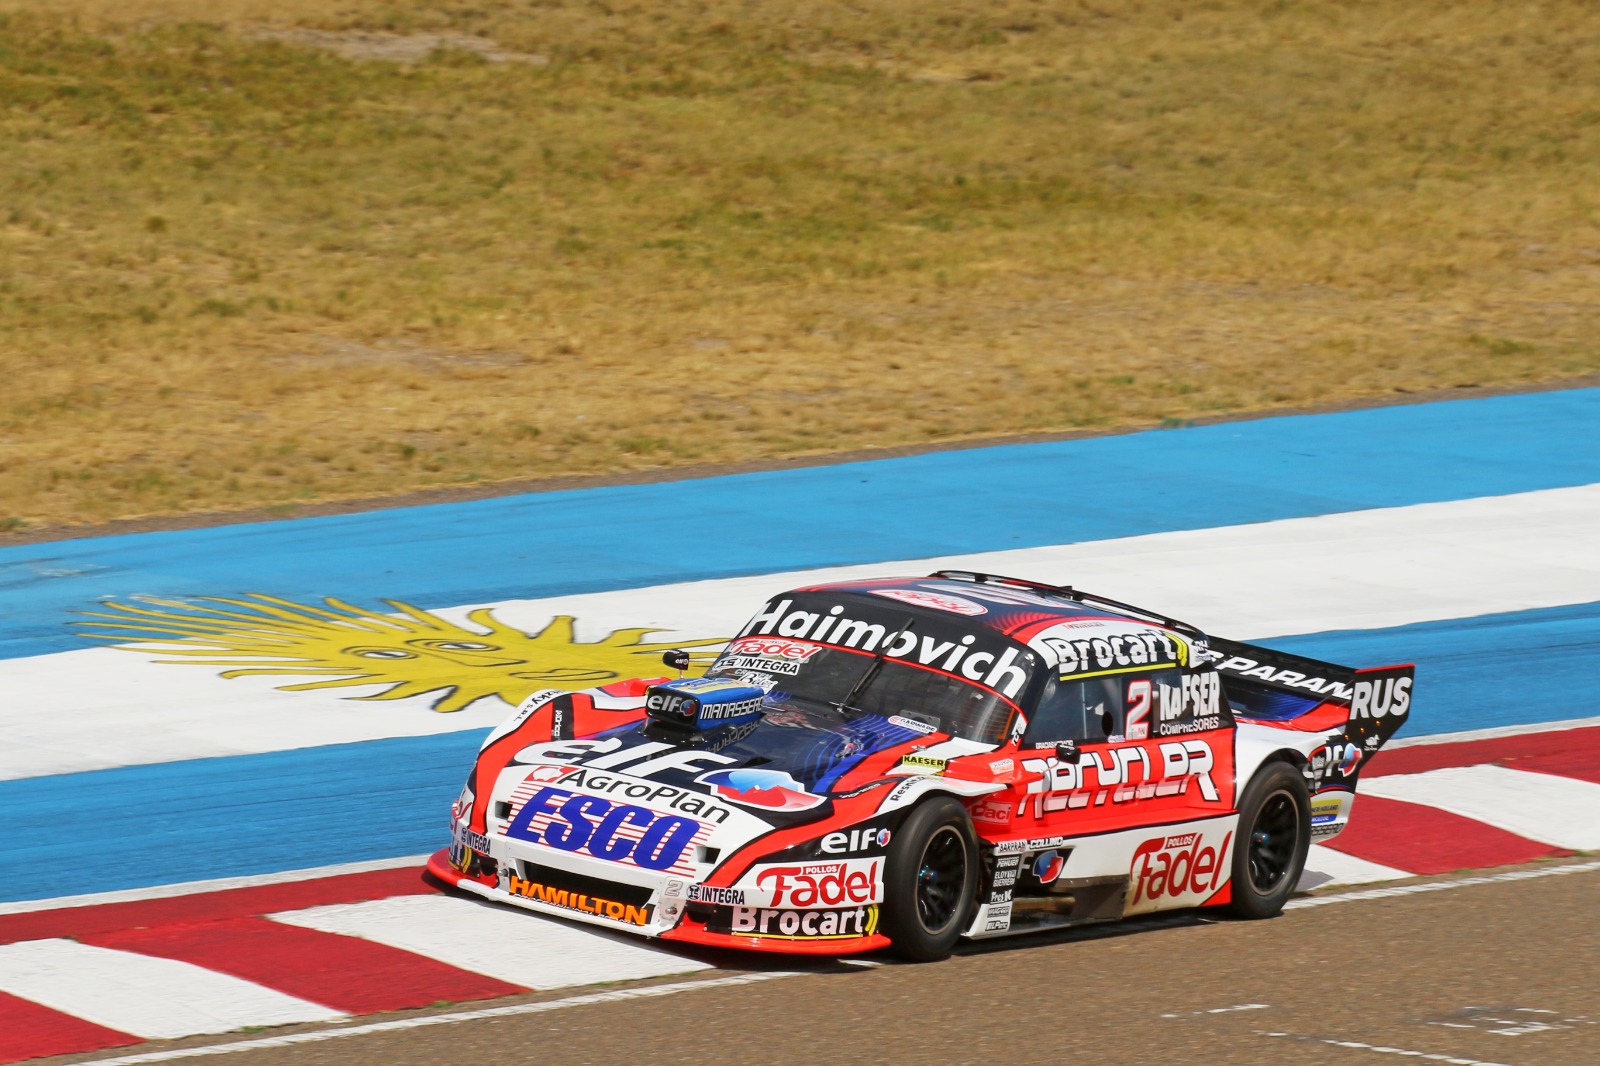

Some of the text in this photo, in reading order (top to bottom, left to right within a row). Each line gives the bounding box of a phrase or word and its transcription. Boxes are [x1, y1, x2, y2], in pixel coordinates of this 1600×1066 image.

[731, 639, 821, 659] Fadel
[741, 599, 1027, 698] Haimovich
[1042, 630, 1178, 674] Brocart
[742, 658, 798, 674] INTEGRA
[647, 694, 682, 713] elf
[1126, 680, 1152, 740] 2
[1160, 671, 1220, 721] KAESER
[1350, 677, 1413, 720] RUS
[1159, 717, 1220, 735] COMPRESORES
[513, 738, 738, 779] elf
[904, 755, 944, 767] KAESER
[467, 830, 491, 855] INTEGRA
[506, 786, 701, 871] ESCO
[821, 828, 877, 853] elf
[1168, 836, 1193, 847] POLLOS
[805, 865, 838, 874] POLLOS
[1130, 830, 1232, 906] Fadel
[701, 887, 745, 905] INTEGRA
[756, 861, 878, 907] Fadel
[509, 876, 647, 926] HAMILTON
[731, 906, 866, 936] Brocart
